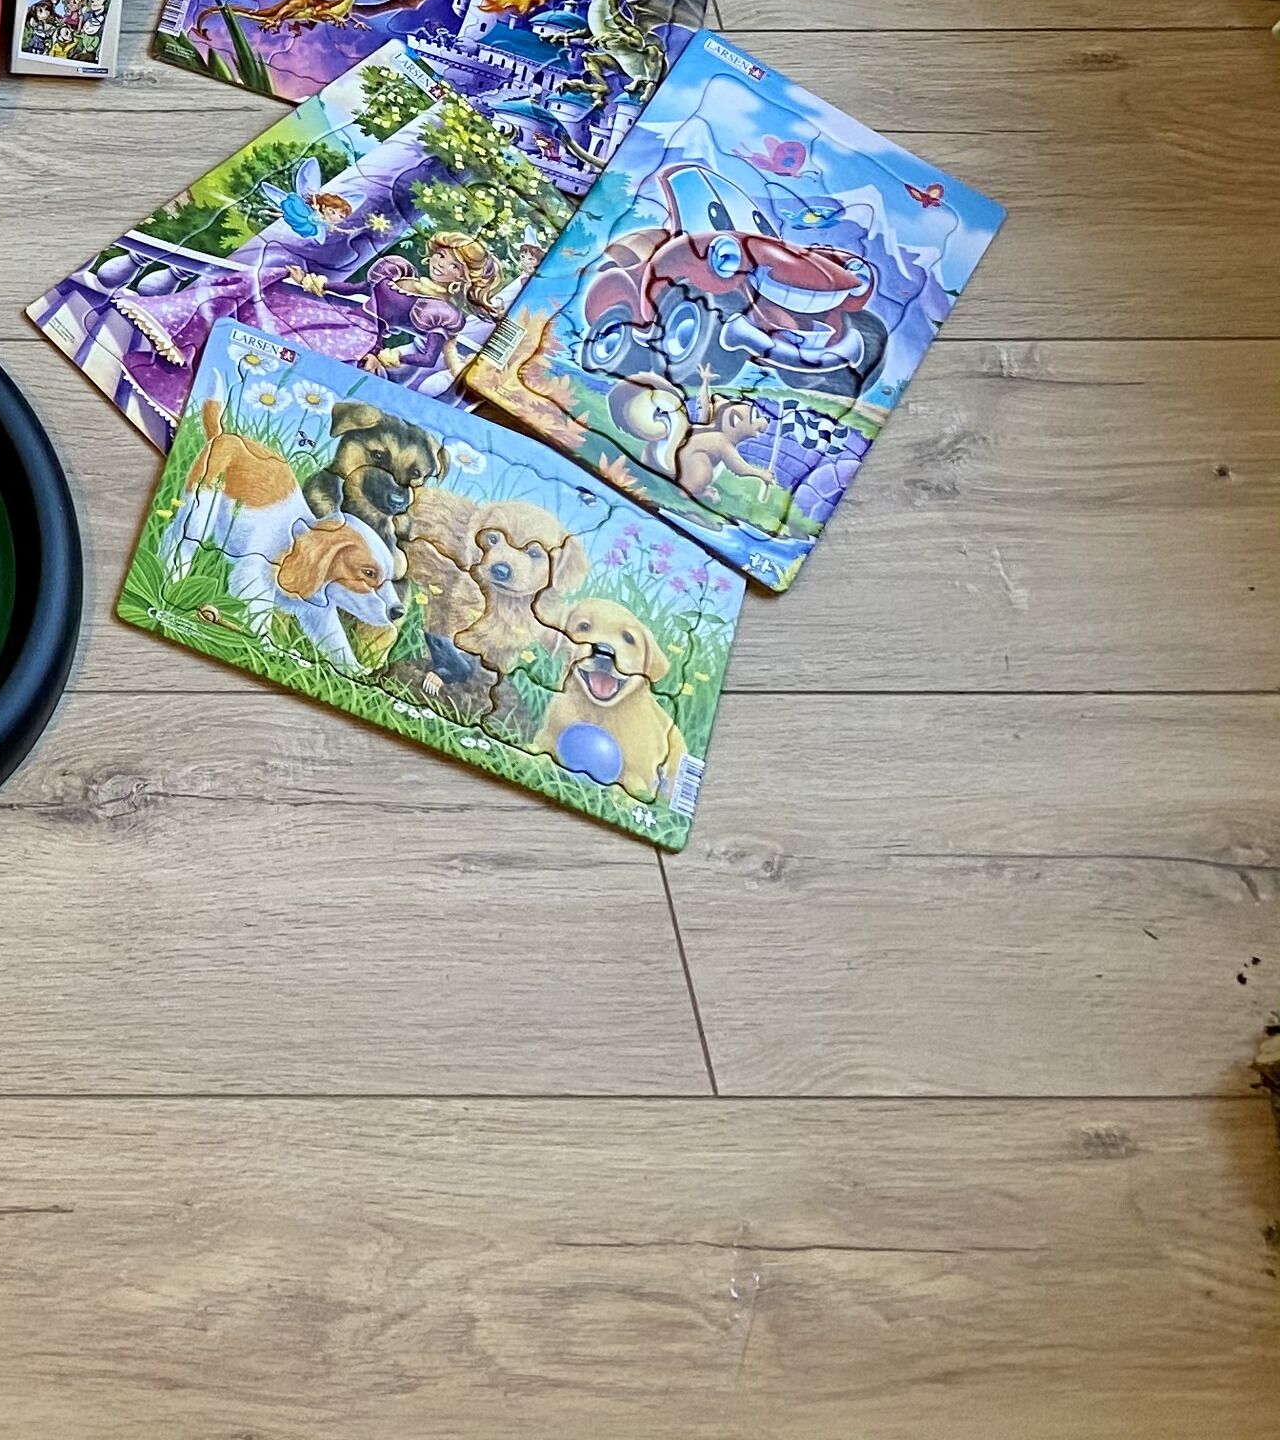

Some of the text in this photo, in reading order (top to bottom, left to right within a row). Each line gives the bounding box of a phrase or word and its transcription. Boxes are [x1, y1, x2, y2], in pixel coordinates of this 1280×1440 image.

[394, 52, 432, 88] LARSEN
[706, 40, 750, 70] LARSEN
[232, 330, 280, 355] LARSEN
